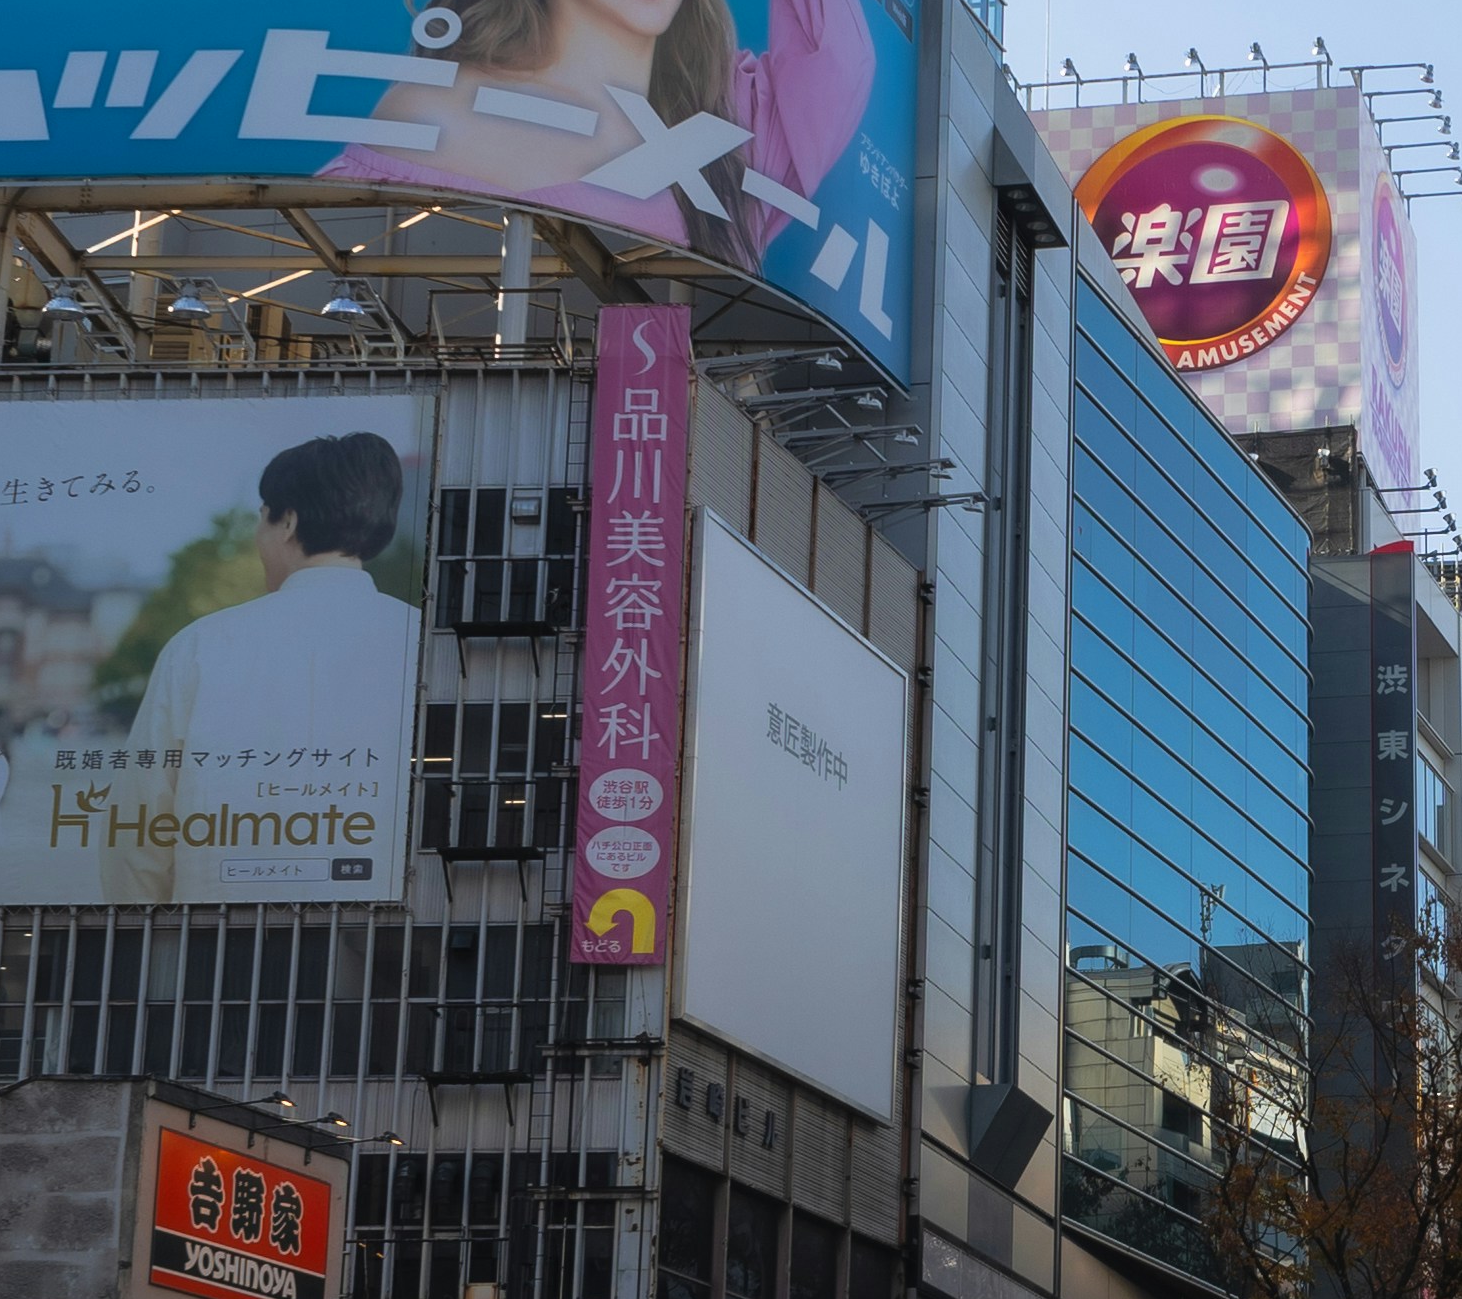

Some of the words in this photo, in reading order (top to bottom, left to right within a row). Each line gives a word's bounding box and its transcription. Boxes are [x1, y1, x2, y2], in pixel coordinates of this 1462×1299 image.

[859, 151, 900, 212] ゆきぽよ
[1111, 200, 1290, 288] 楽園
[1176, 270, 1319, 370] AMUSEMENT
[596, 388, 670, 763] 品川美容外科
[767, 701, 849, 792] 意匠製作中
[54, 747, 380, 771] 既婚者専用マッチングサイト
[602, 780, 650, 795] 渋谷駅
[596, 795, 654, 811] 徒歩1分
[107, 802, 376, 848] Healmate
[591, 841, 653, 852] ハチ公口正面
[595, 852, 647, 862] にあるビル
[226, 864, 303, 877] ヒールメイト
[340, 862, 364, 876] 検索
[611, 862, 632, 873] です
[580, 939, 622, 954] もどる
[188, 1155, 305, 1258] 吉野家
